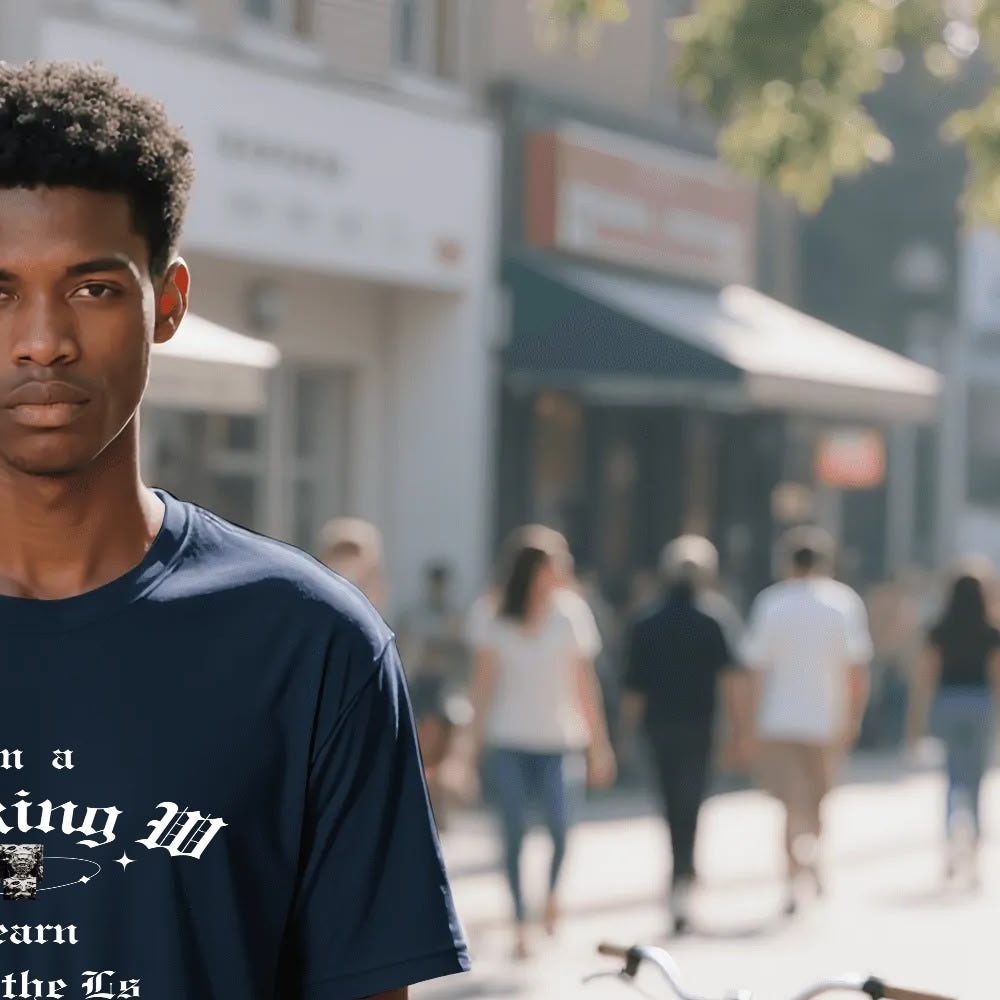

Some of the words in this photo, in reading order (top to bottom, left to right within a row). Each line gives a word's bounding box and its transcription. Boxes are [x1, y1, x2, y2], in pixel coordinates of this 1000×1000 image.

[52, 749, 74, 769] a
[135, 802, 228, 859] W
[82, 971, 140, 999] Ls
